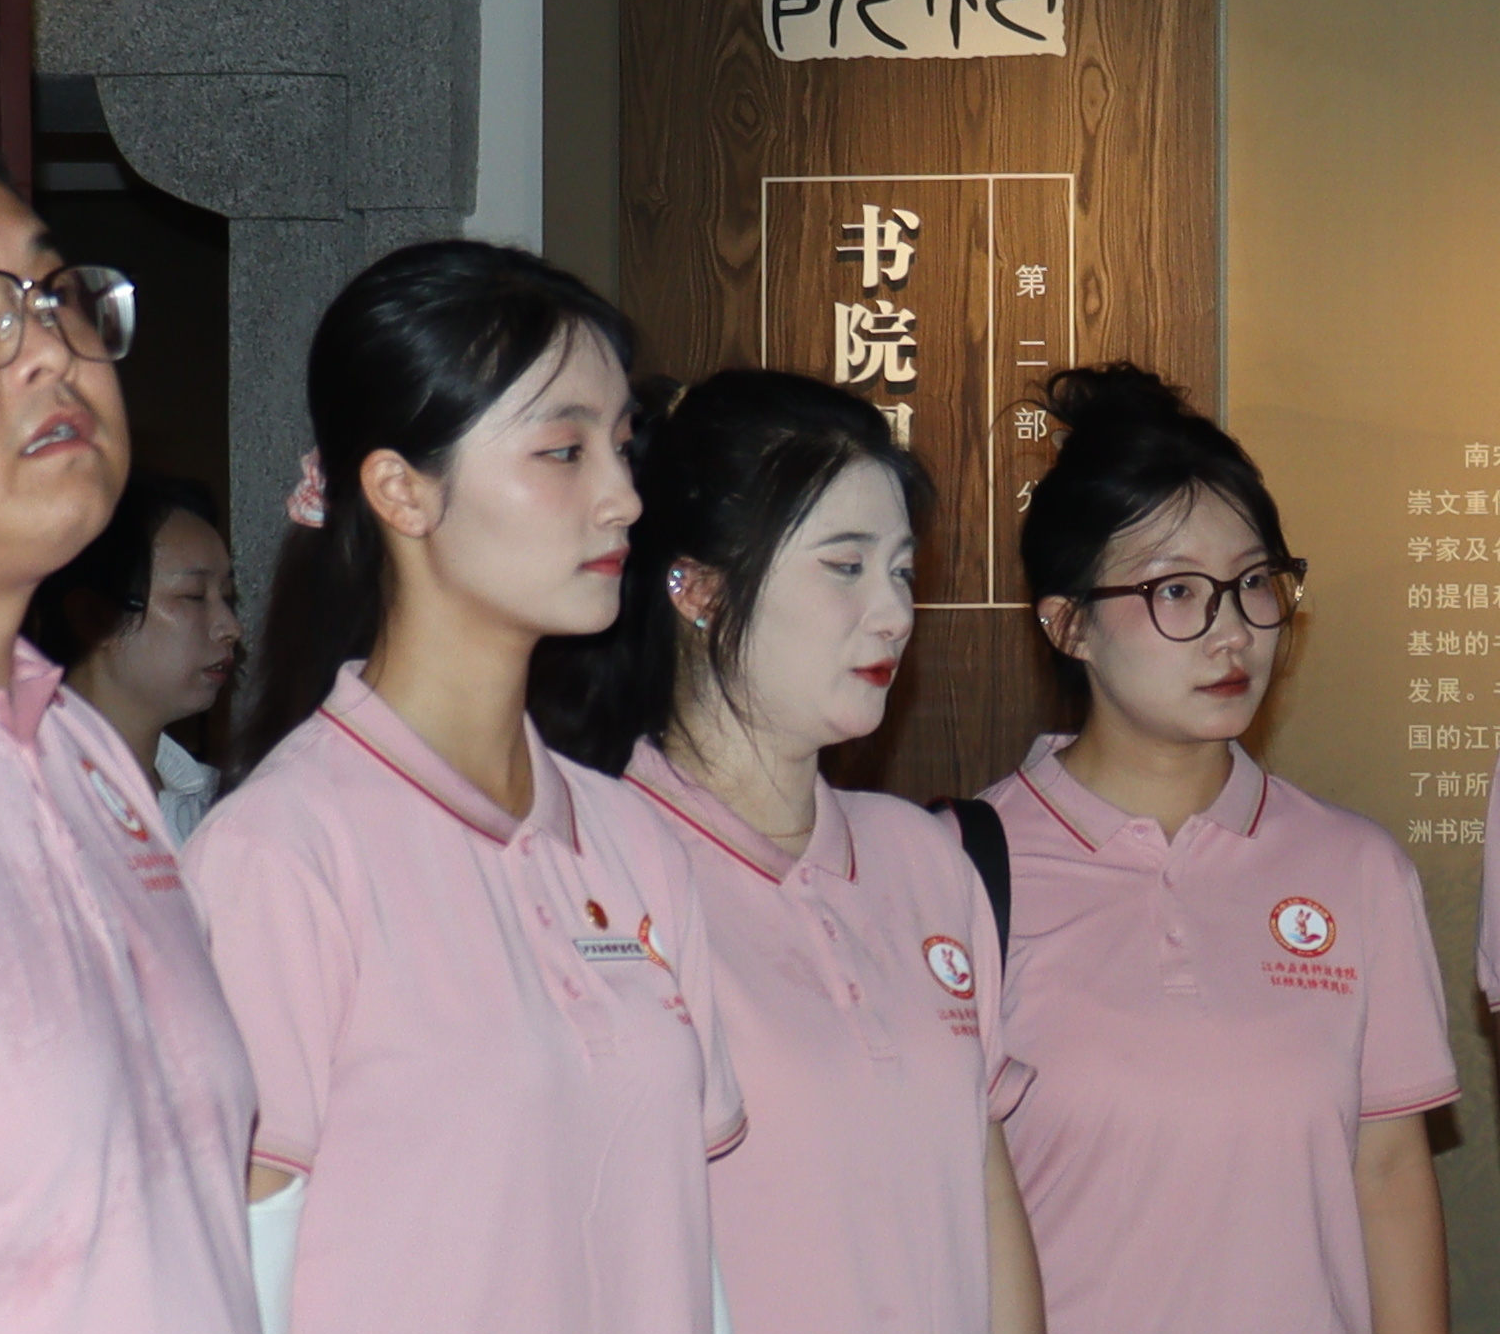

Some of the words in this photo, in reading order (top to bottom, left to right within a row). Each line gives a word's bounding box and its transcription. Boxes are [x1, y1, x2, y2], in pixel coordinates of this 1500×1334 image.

[833, 204, 920, 453] 书院
[1408, 771, 1490, 798] 了前所
[1407, 818, 1485, 845] 洲书院
